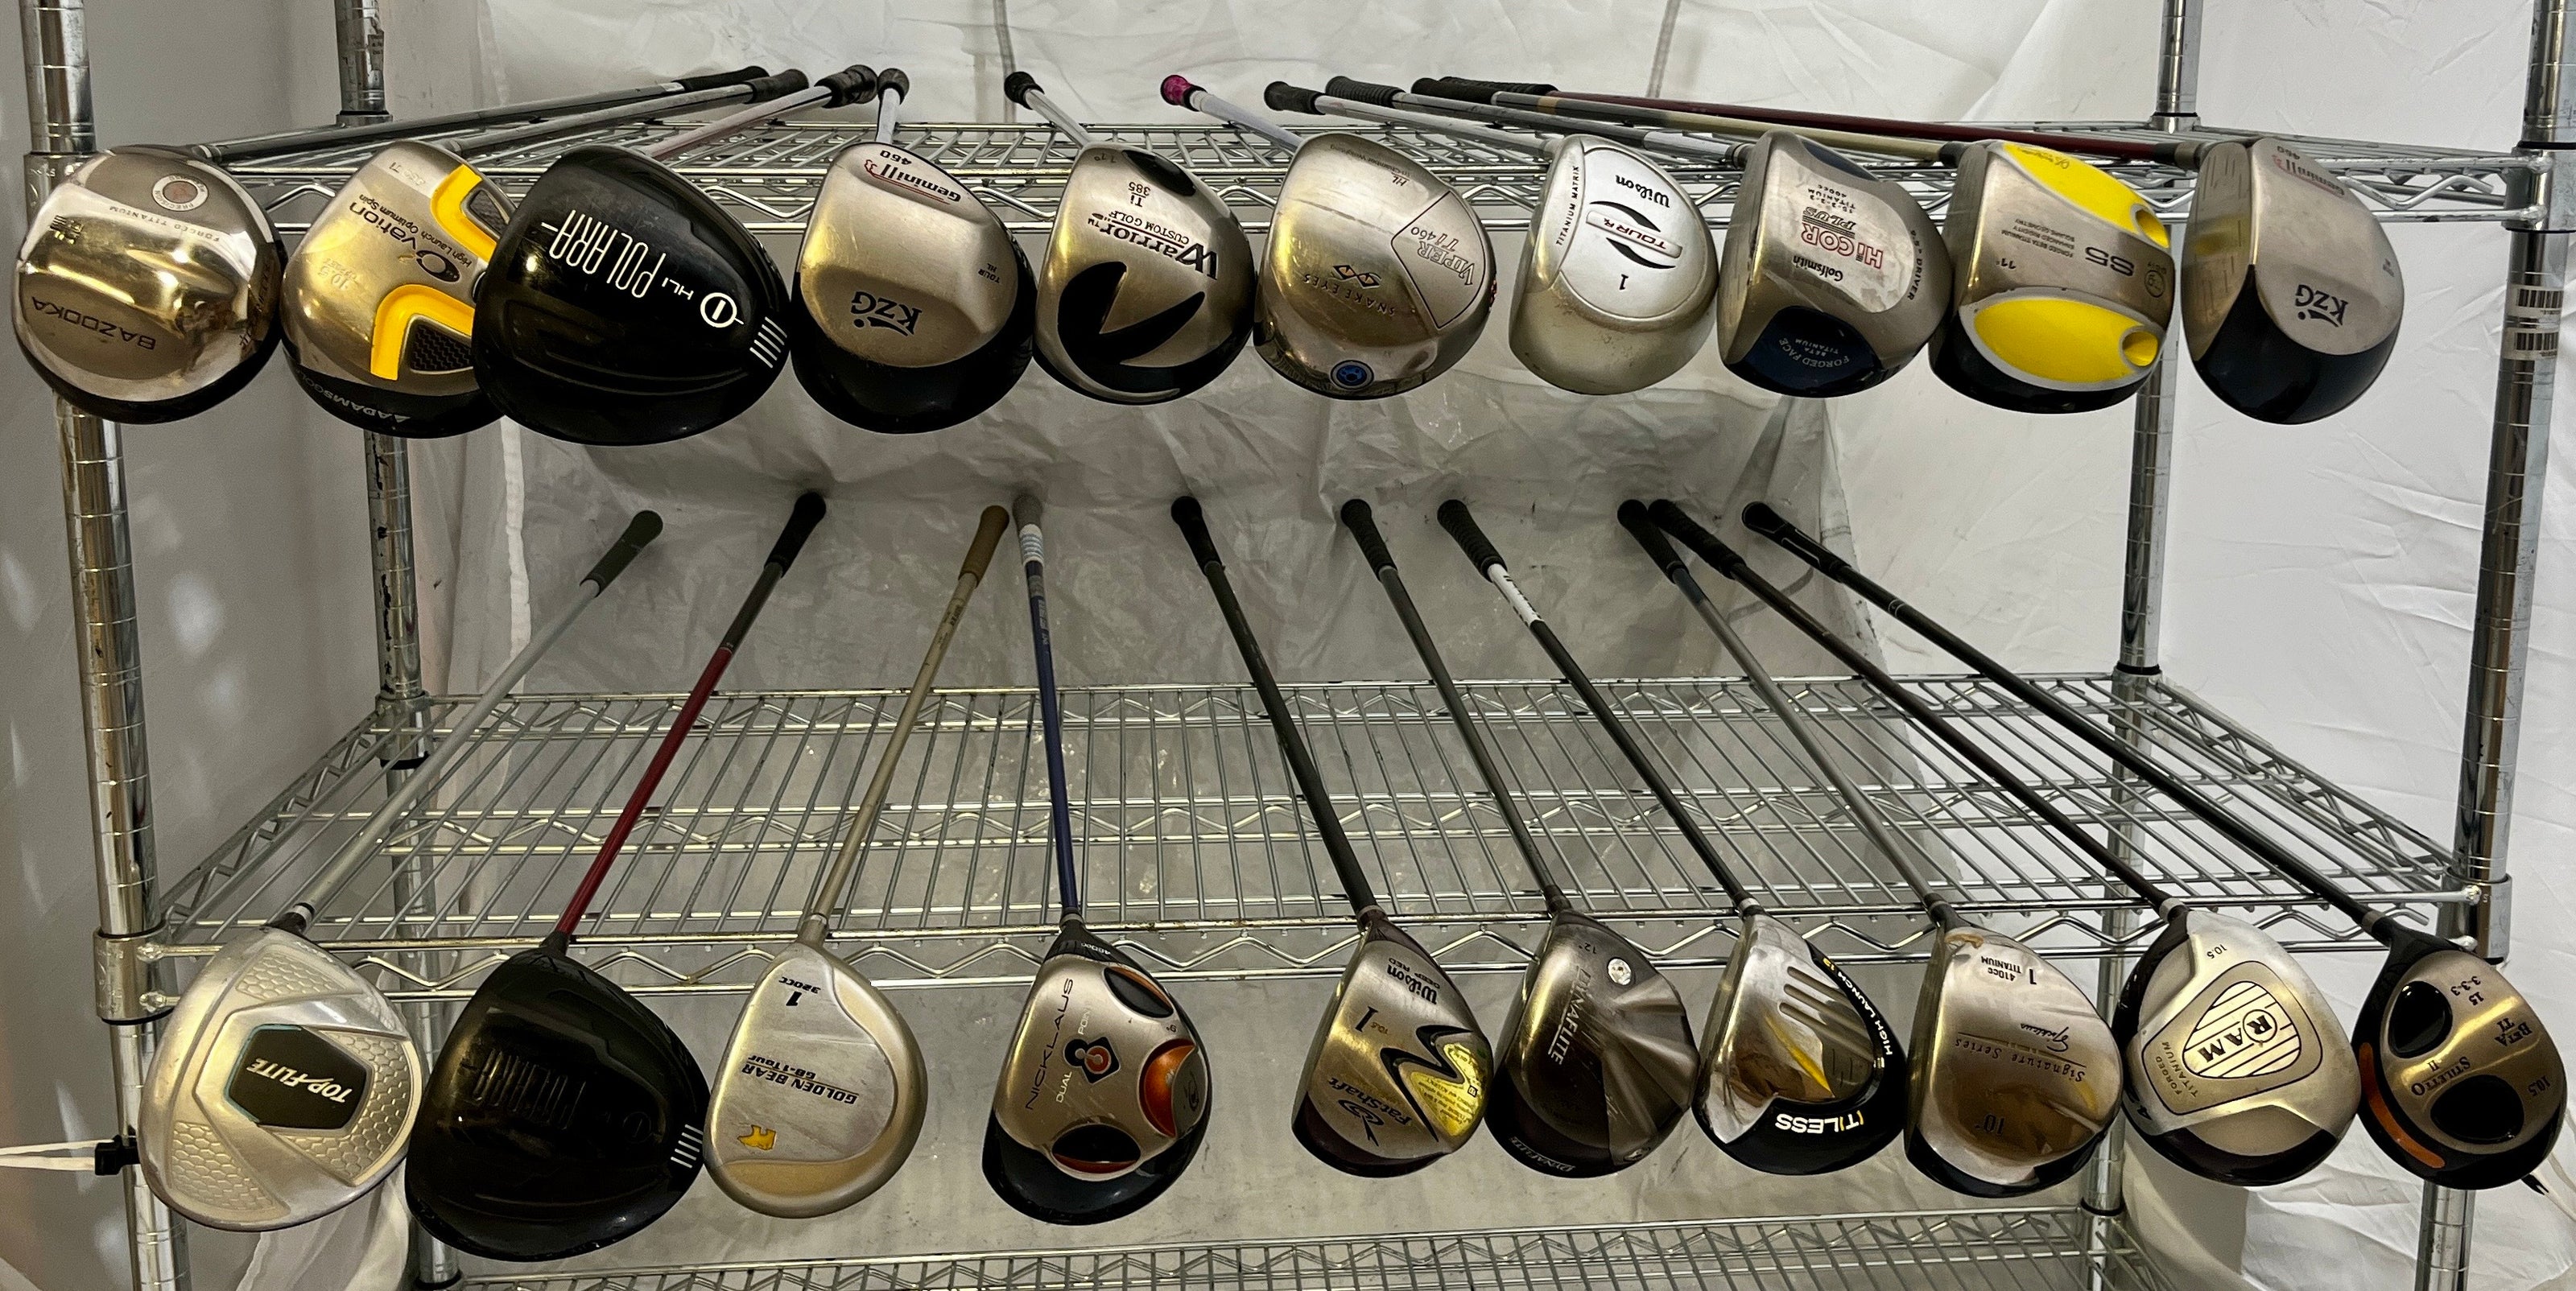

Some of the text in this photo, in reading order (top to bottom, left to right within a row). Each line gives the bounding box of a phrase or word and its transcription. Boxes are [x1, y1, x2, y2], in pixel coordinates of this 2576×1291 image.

[880, 150, 912, 165] 460
[1129, 181, 1151, 196] 385
[1391, 175, 1408, 187] HL
[1615, 174, 1670, 208] Wilson
[1130, 195, 1143, 208] Ti
[1807, 188, 1856, 210] TITANIUM
[109, 206, 170, 227] TITANIUM
[359, 195, 473, 267] High Launch Optimum Spin
[1108, 210, 1190, 245] CUSTOM GOLF
[1556, 202, 1576, 246] TITANIUM
[1802, 206, 1856, 231] PLUS
[349, 202, 461, 283] Ovation
[1100, 223, 1217, 280] Warrior
[1410, 226, 1435, 247] 460
[1616, 225, 1666, 250] TOUR
[1801, 224, 1884, 269] Hi COR
[2001, 229, 2074, 258] FORGED BETA TITANIUM
[548, 209, 667, 299] POLARA
[1418, 241, 1474, 287] VIPER
[1793, 255, 1843, 282] Golfsmith
[977, 268, 1001, 283] TOUR
[1619, 274, 1629, 290] 1
[1907, 258, 1922, 301] DRIVER
[1303, 273, 1395, 316] SNAKE EYES
[2294, 284, 2349, 326] KZG
[31, 296, 157, 350] BAZOOKA
[850, 291, 923, 336] KZG
[1778, 337, 1850, 368] FORGED FACE
[1794, 338, 1839, 354] TITANIUM
[1804, 347, 1827, 356] BETA
[1981, 955, 2021, 974] TITANIUM
[2207, 943, 2227, 959] 10.5
[778, 976, 822, 994] 320cc
[1387, 963, 1437, 1005] Wilson
[1389, 957, 1440, 989] DEEP RED
[1988, 967, 2016, 982] 410cc
[2029, 968, 2037, 985] 1
[2450, 975, 2482, 996] 3-3-3
[786, 991, 803, 1006] 1
[1837, 971, 1877, 1018] LAUNCH
[2469, 992, 2484, 1006] 15
[1550, 966, 1592, 1066] DYNAFLITE
[1025, 977, 1074, 1110] NICKLAUS
[1872, 1021, 1893, 1056] HIGH
[2197, 1013, 2274, 1063] RAM
[2495, 1022, 2533, 1046] BETA
[1955, 1039, 2086, 1083] Signature Series
[2154, 1056, 2182, 1095] FORGED
[2162, 1041, 2199, 1098] TITANIUM
[2411, 1057, 2471, 1096] STILETTO
[741, 1064, 859, 1105] GOLDEN BEAR
[1055, 1070, 1072, 1103] DUAL
[1328, 1077, 1412, 1125] FatShaft
[1509, 1136, 1577, 1172] DYNAFLITE
